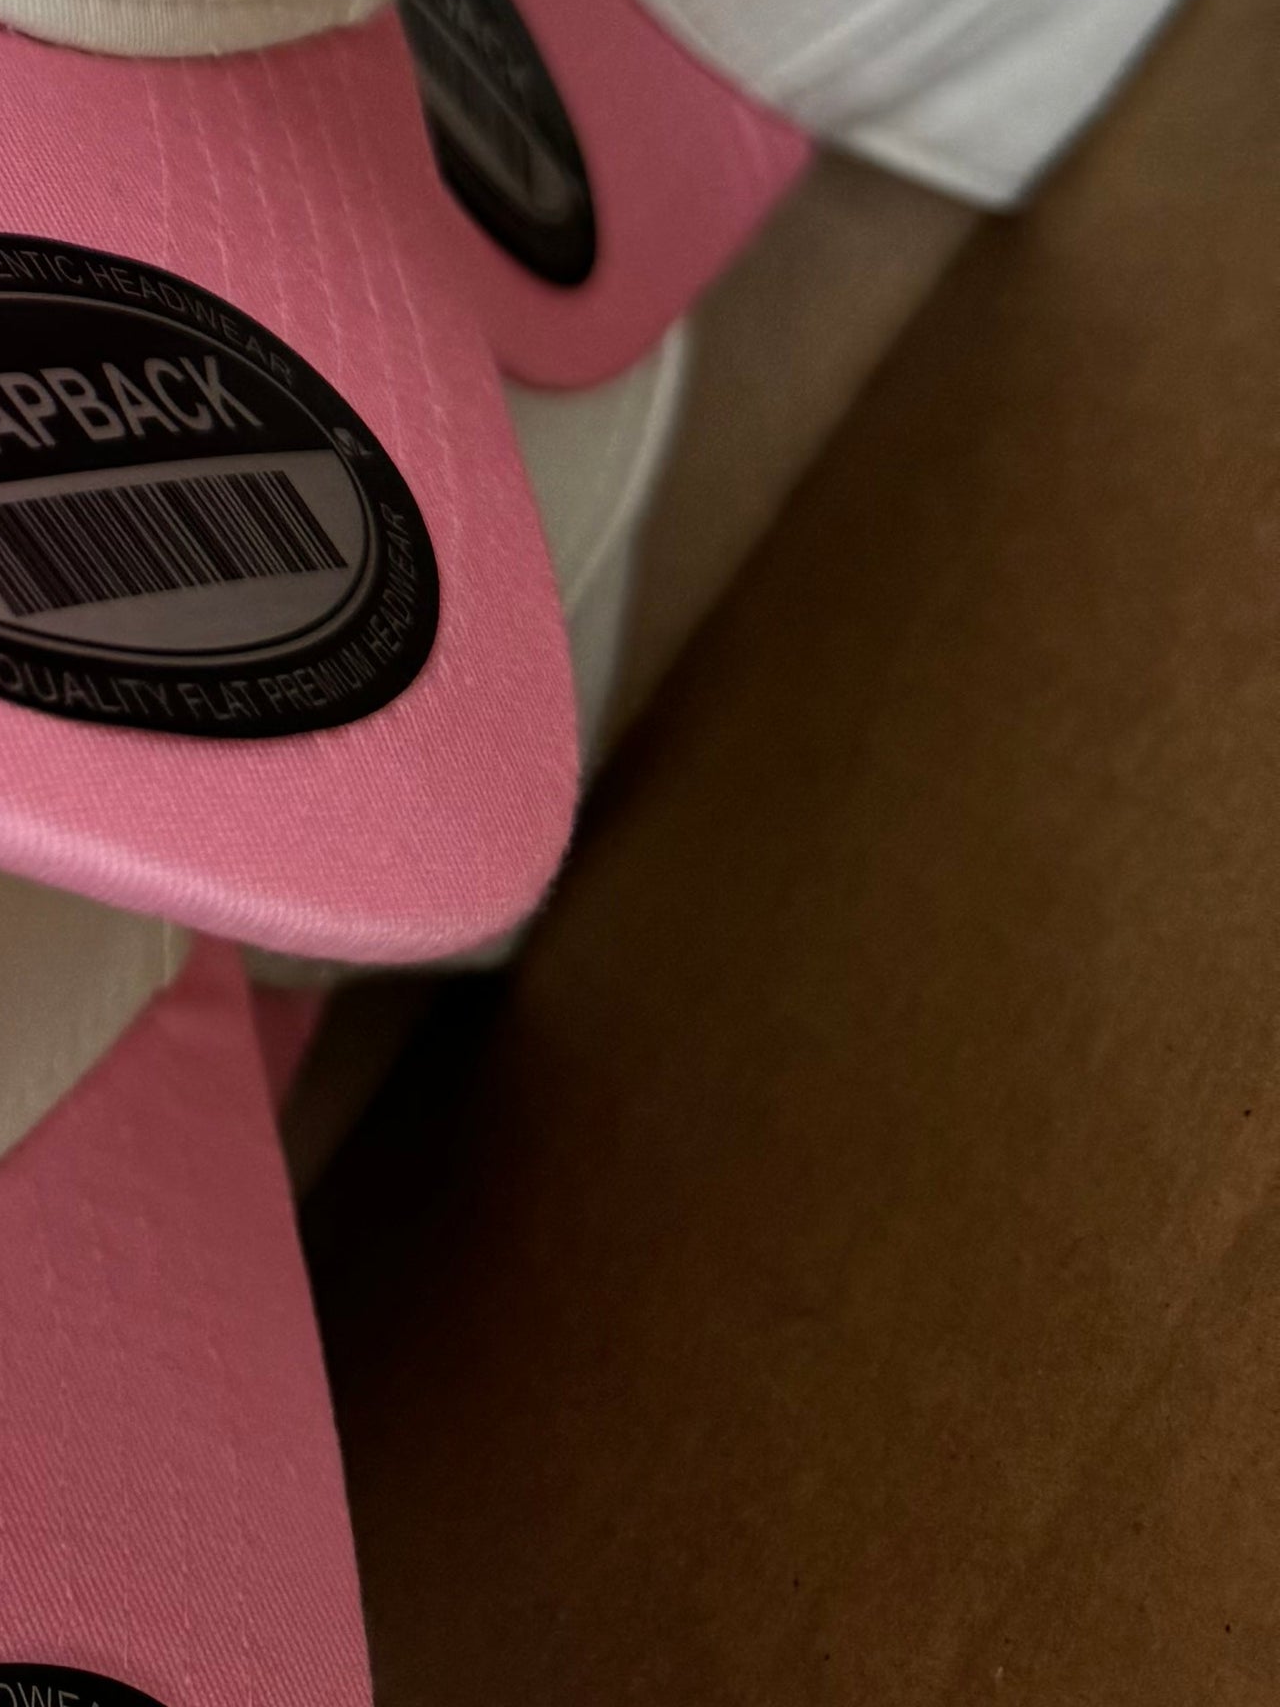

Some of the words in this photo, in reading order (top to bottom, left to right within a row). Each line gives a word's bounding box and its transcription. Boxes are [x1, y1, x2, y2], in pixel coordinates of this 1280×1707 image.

[85, 260, 292, 385] HEADWEAR
[177, 682, 261, 721] FLAT
[257, 641, 377, 716] PREMIUM
[361, 502, 418, 665] HEADWEAR
